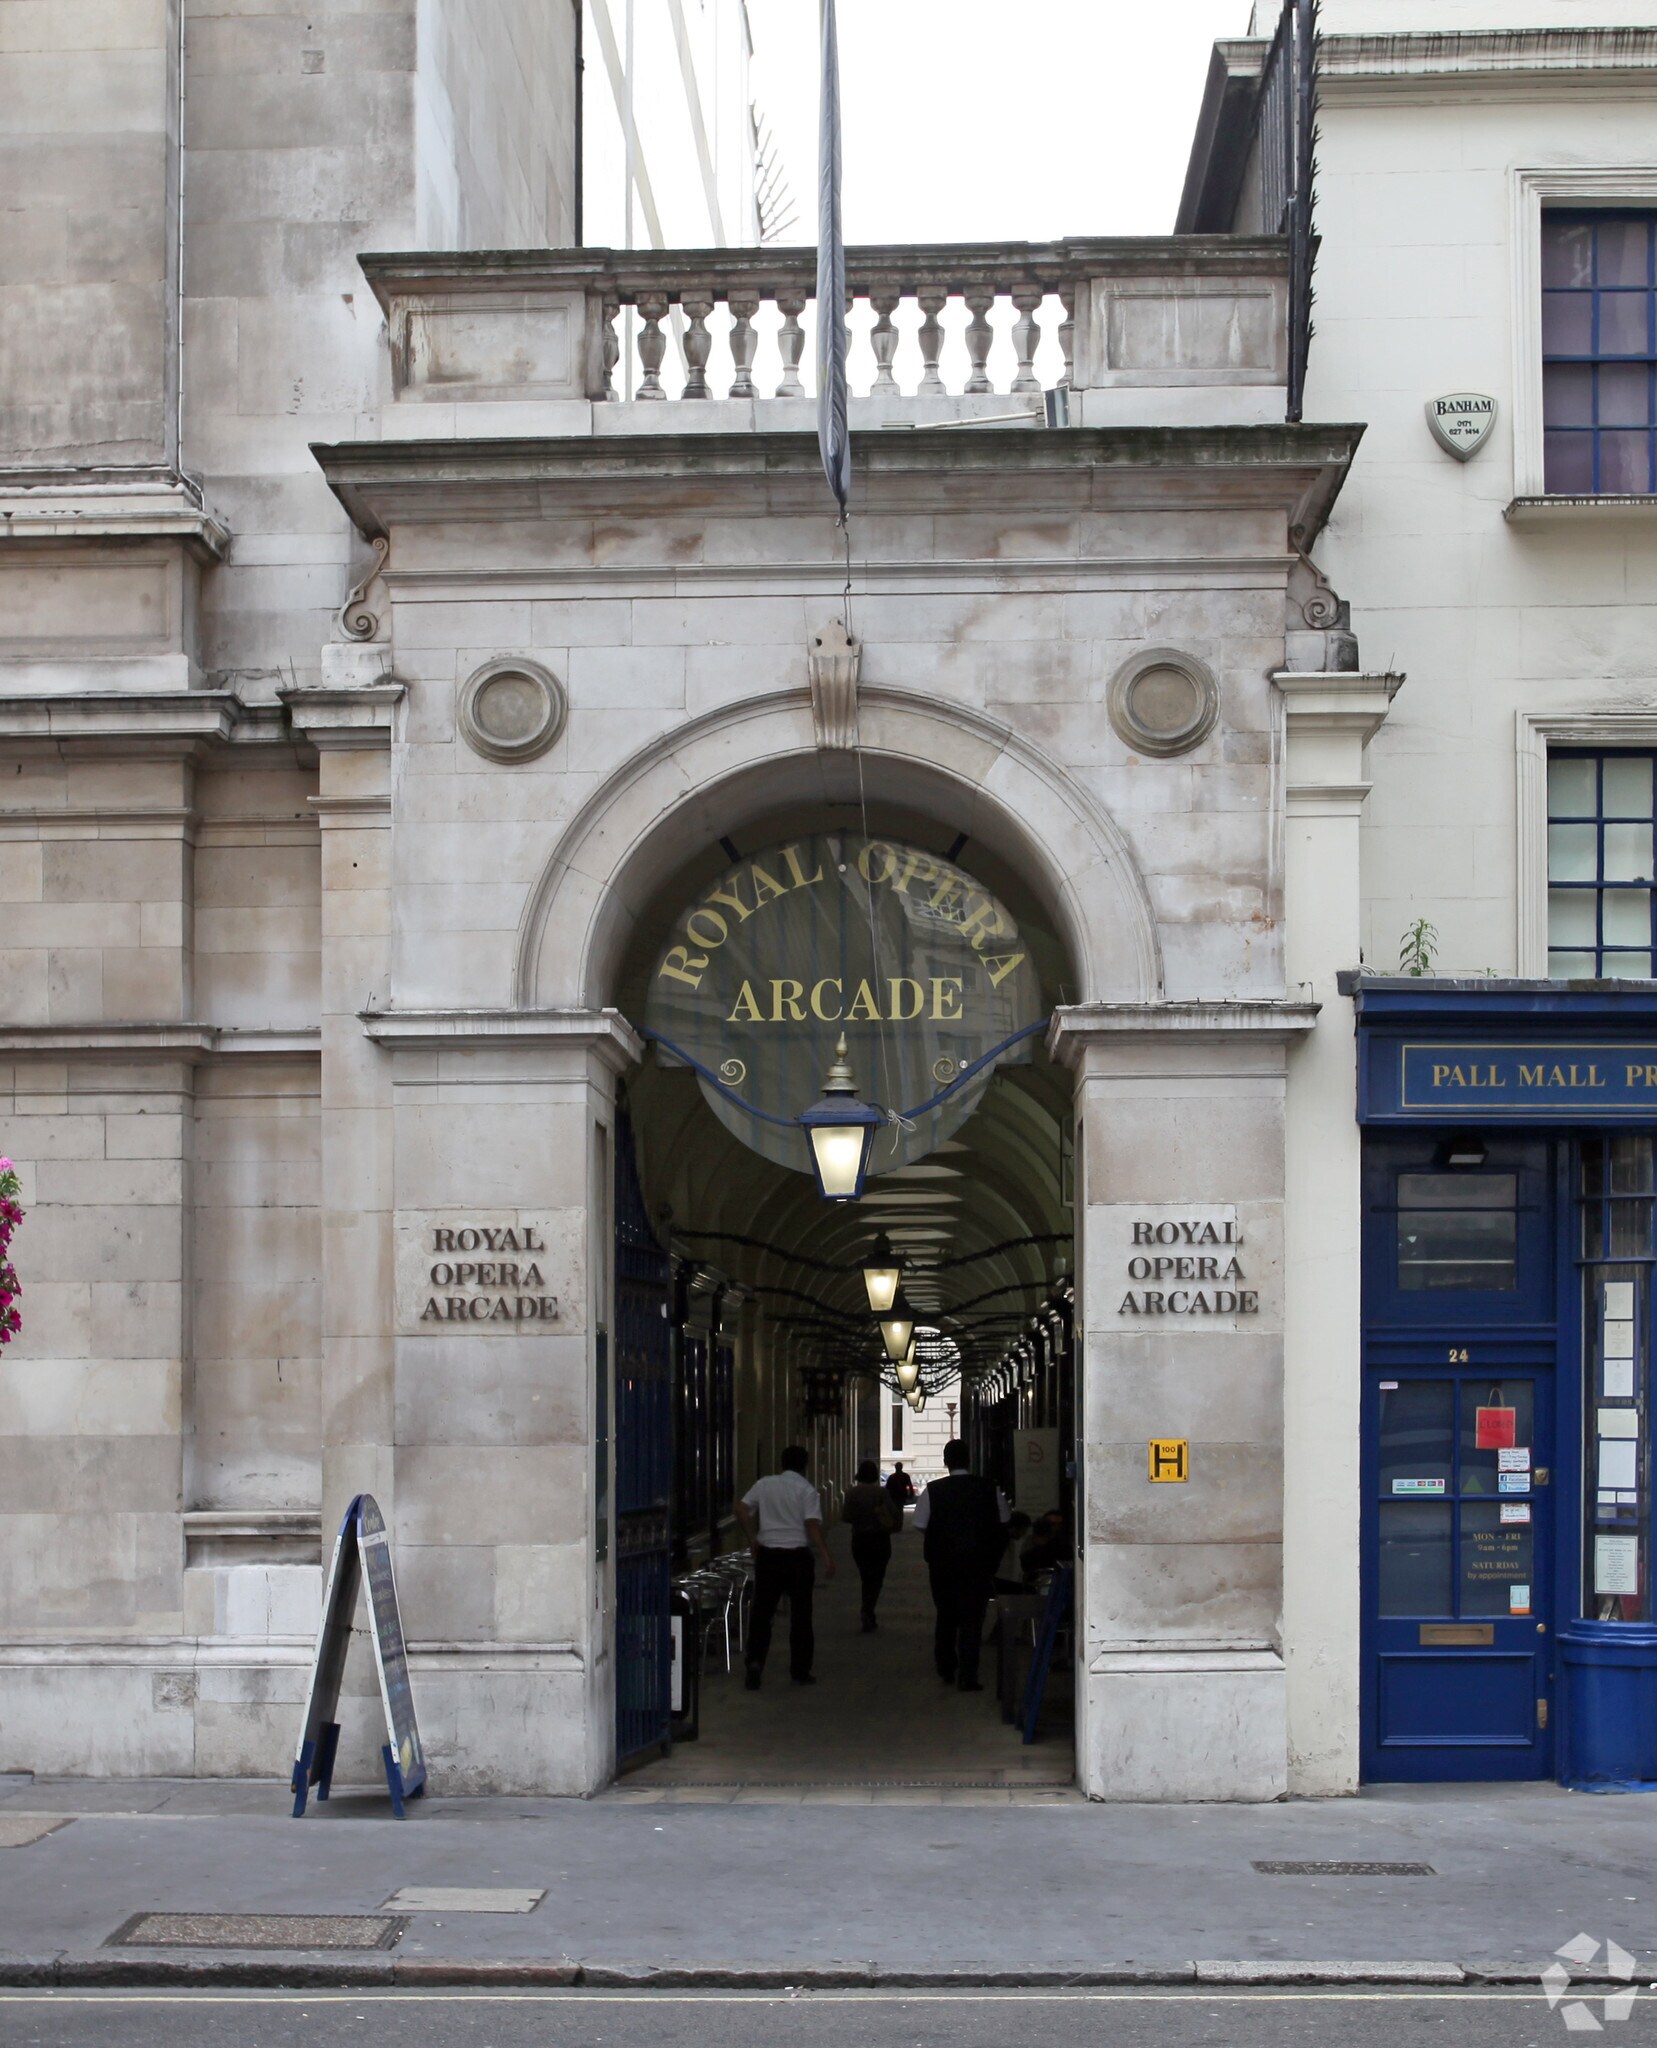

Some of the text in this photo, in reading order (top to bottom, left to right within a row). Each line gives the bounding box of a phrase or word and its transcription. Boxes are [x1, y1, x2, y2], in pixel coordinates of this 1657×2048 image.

[1437, 400, 1492, 415] BANHAM
[658, 842, 1026, 991] ROYAL OPERA
[726, 977, 964, 1022] ARCADE
[1432, 1065, 1507, 1087] PALL
[1517, 1065, 1606, 1087] MALL
[433, 1227, 545, 1251] ROYAL
[1131, 1221, 1244, 1245] ROYAL
[430, 1262, 546, 1286] OPERA
[1128, 1256, 1246, 1280] OPERA
[420, 1296, 559, 1321] ARCADE
[1117, 1290, 1259, 1314] ARCADE
[1449, 1349, 1468, 1362] 24
[1154, 1444, 1183, 1478] H
[1473, 1533, 1495, 1541] MON
[1505, 1533, 1521, 1541] FRI
